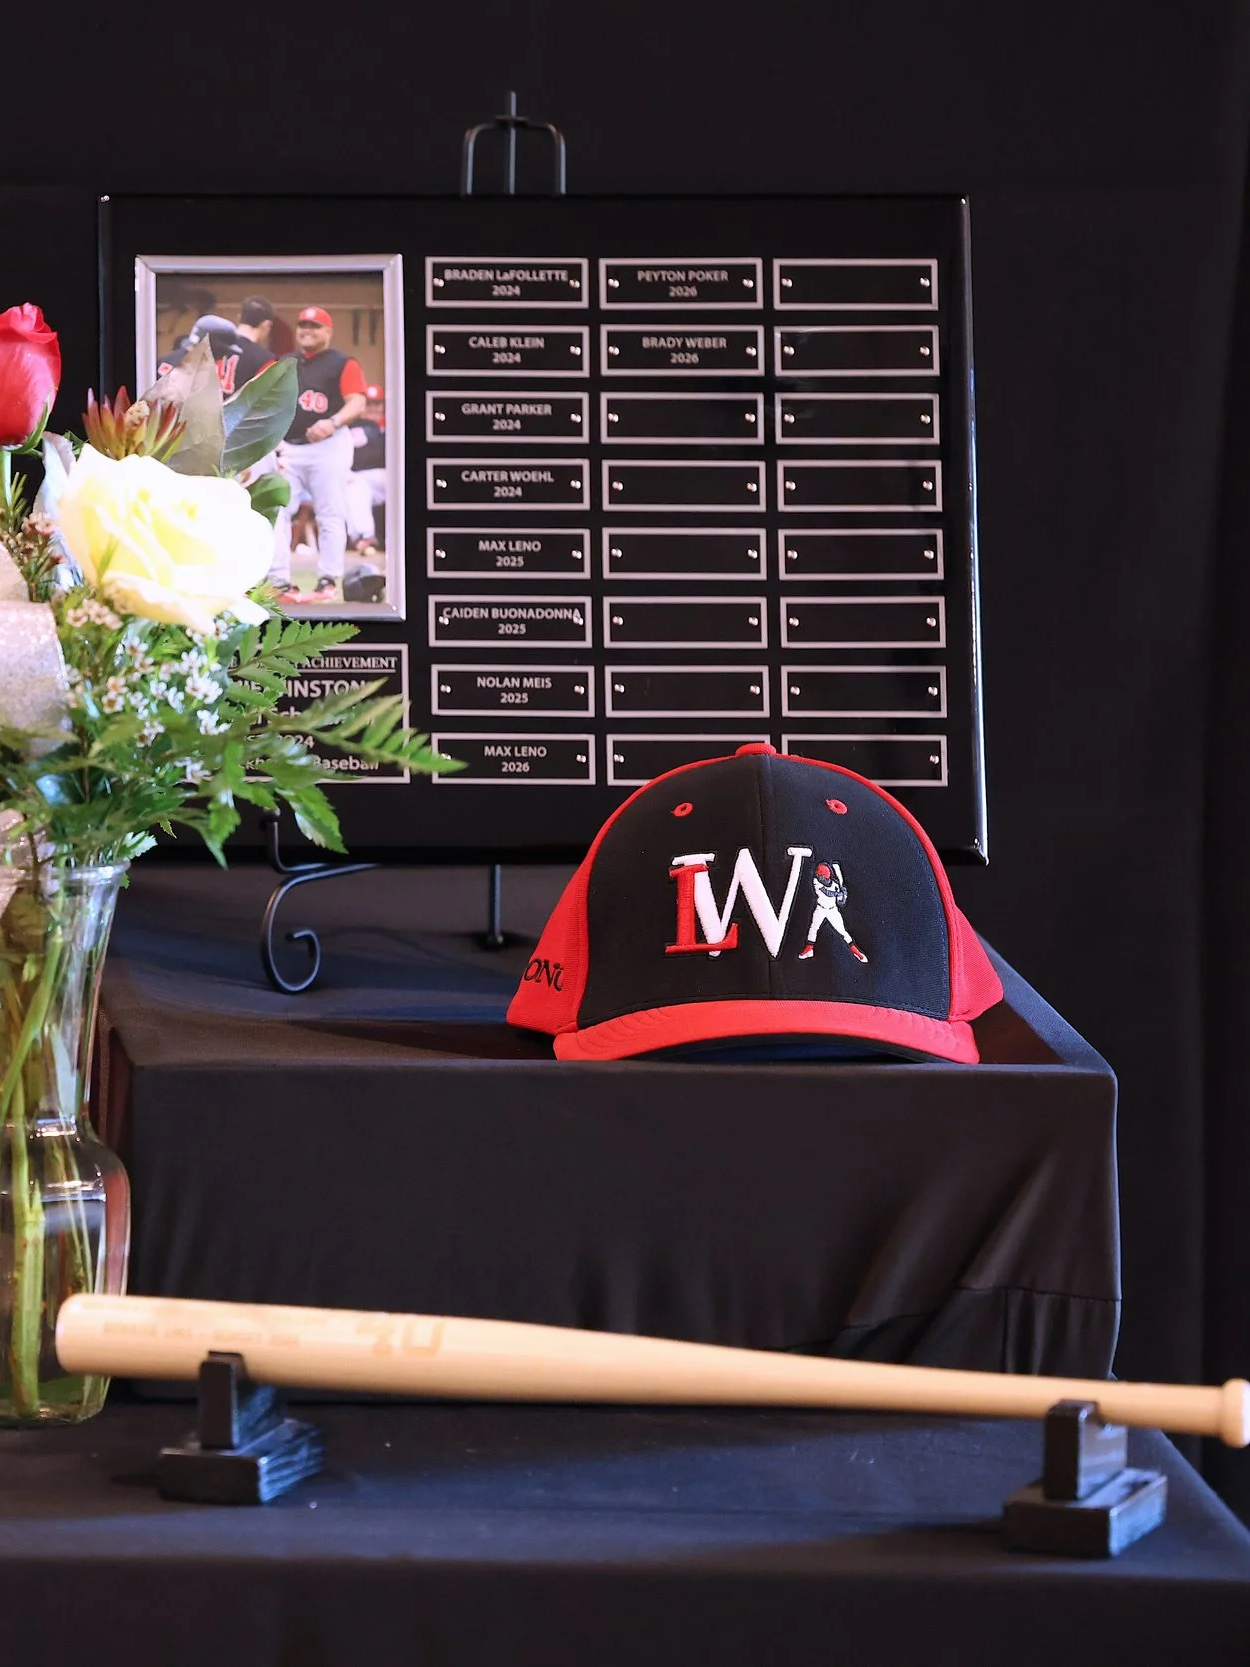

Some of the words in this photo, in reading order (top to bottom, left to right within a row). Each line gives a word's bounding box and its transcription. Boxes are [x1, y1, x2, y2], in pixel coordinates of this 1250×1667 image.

[443, 269, 494, 282] BRADEN
[496, 269, 569, 282] LaFOLLETTE
[637, 270, 685, 282] PEYTON
[688, 270, 729, 282] POKER
[492, 285, 521, 297] 2024
[669, 286, 698, 297] 2026
[468, 337, 507, 348] CALEB
[509, 337, 545, 348] KLEIN
[641, 337, 683, 348] BRADY
[685, 337, 727, 349] WEBER
[492, 352, 521, 364] 2024
[670, 353, 699, 364] 2026
[461, 403, 504, 415] GRANT
[506, 403, 552, 415] PARKER
[492, 419, 521, 431] 2024
[461, 470, 508, 483] CARTER
[509, 470, 555, 483] WOEHL
[493, 486, 522, 498] 2024
[478, 540, 507, 552] MAX
[509, 540, 542, 552] LENO
[495, 556, 524, 567] 2025
[443, 607, 490, 619] CAIDEN
[491, 608, 581, 620] BUONADONNA
[497, 623, 526, 635] 2025
[305, 656, 398, 669] ACHIEVEMENT
[476, 676, 521, 689] NOLAN
[522, 676, 553, 689] MEIS
[500, 692, 529, 704] 2025
[483, 745, 512, 757] MAX
[514, 745, 548, 757] LENO
[501, 761, 530, 773] 2026
